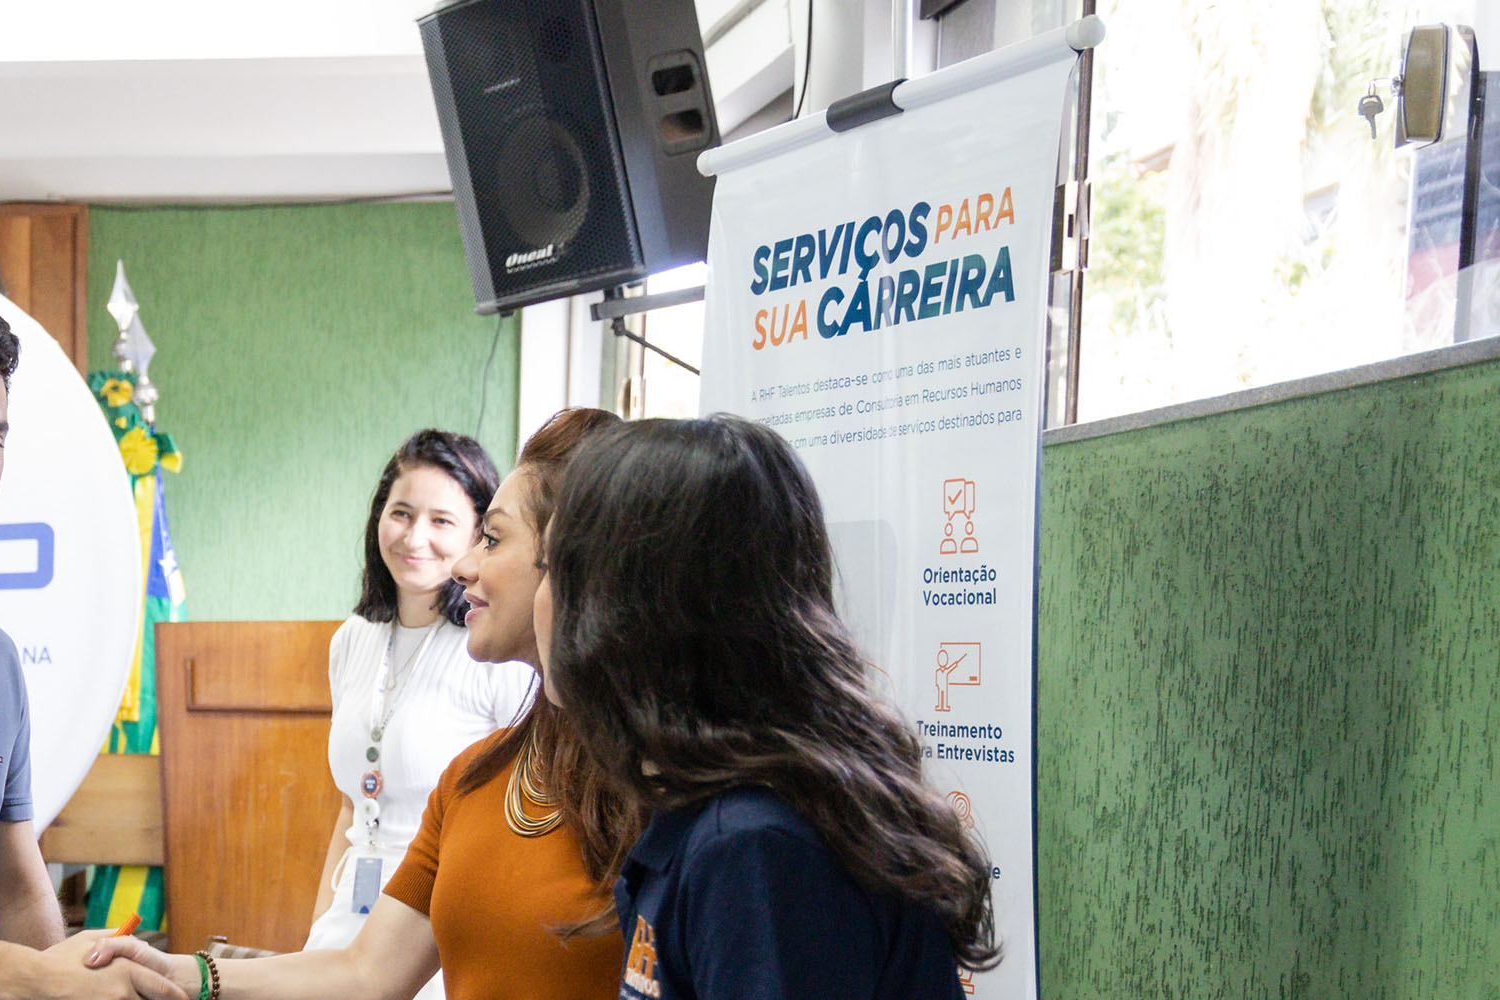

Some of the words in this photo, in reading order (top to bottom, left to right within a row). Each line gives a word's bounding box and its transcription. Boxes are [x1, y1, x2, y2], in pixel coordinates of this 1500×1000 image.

[750, 202, 931, 295] SERVIÇOS
[934, 186, 1015, 244] PARA
[752, 300, 808, 350] SUA
[816, 246, 1015, 340] CARREIRA
[779, 382, 810, 398] Talentos
[813, 374, 868, 392] destaca-se
[895, 365, 913, 379] uma
[917, 360, 934, 375] das
[938, 355, 961, 371] mais
[965, 347, 1011, 367] atuantes
[1015, 347, 1022, 359] e
[795, 406, 836, 423] empresas
[838, 402, 853, 416] de
[905, 393, 919, 406] em
[922, 385, 968, 404] Recursos
[971, 378, 1022, 396] Humanos
[809, 434, 827, 447] uma
[899, 419, 935, 436] serviços
[938, 411, 994, 431] destinados
[998, 408, 1022, 426] para
[923, 565, 997, 586] Orientação
[923, 588, 997, 606] Vocacional
[917, 720, 1002, 740] Treinamento
[937, 743, 1015, 763] Entrevistas
